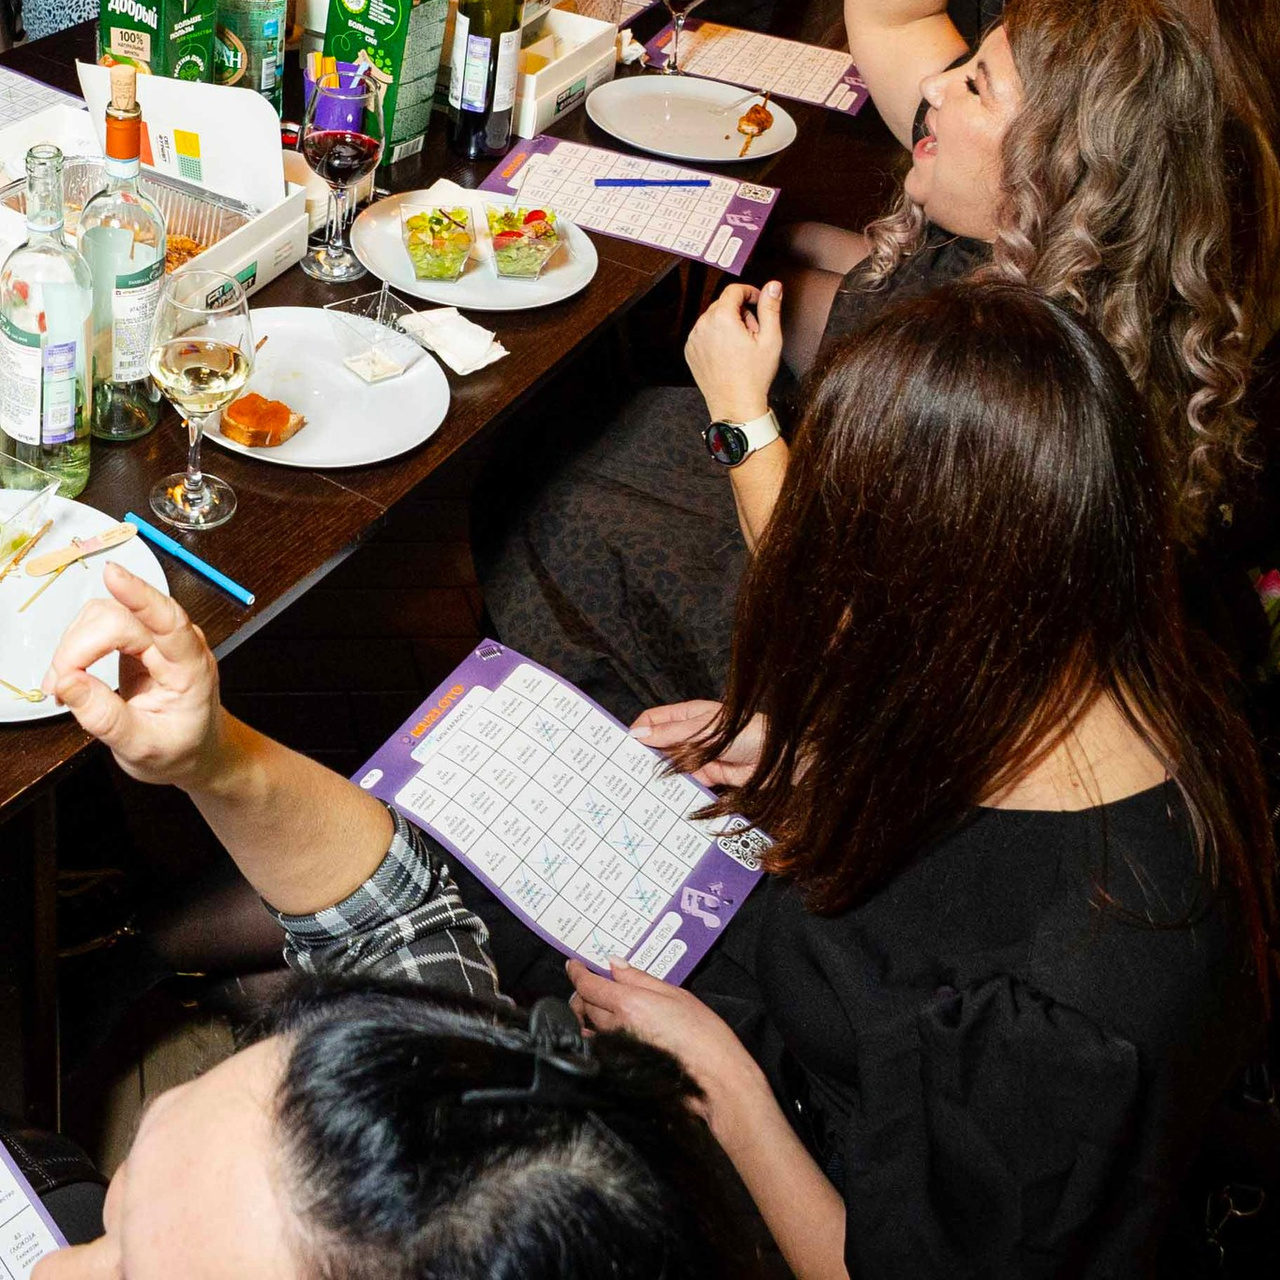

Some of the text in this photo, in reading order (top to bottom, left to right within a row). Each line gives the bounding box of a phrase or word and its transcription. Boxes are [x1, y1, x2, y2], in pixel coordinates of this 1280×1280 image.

[120, 30, 144, 46] 100%
[410, 684, 465, 739] MUZLOTO
[650, 939, 684, 979] ZLOTO.SPB
